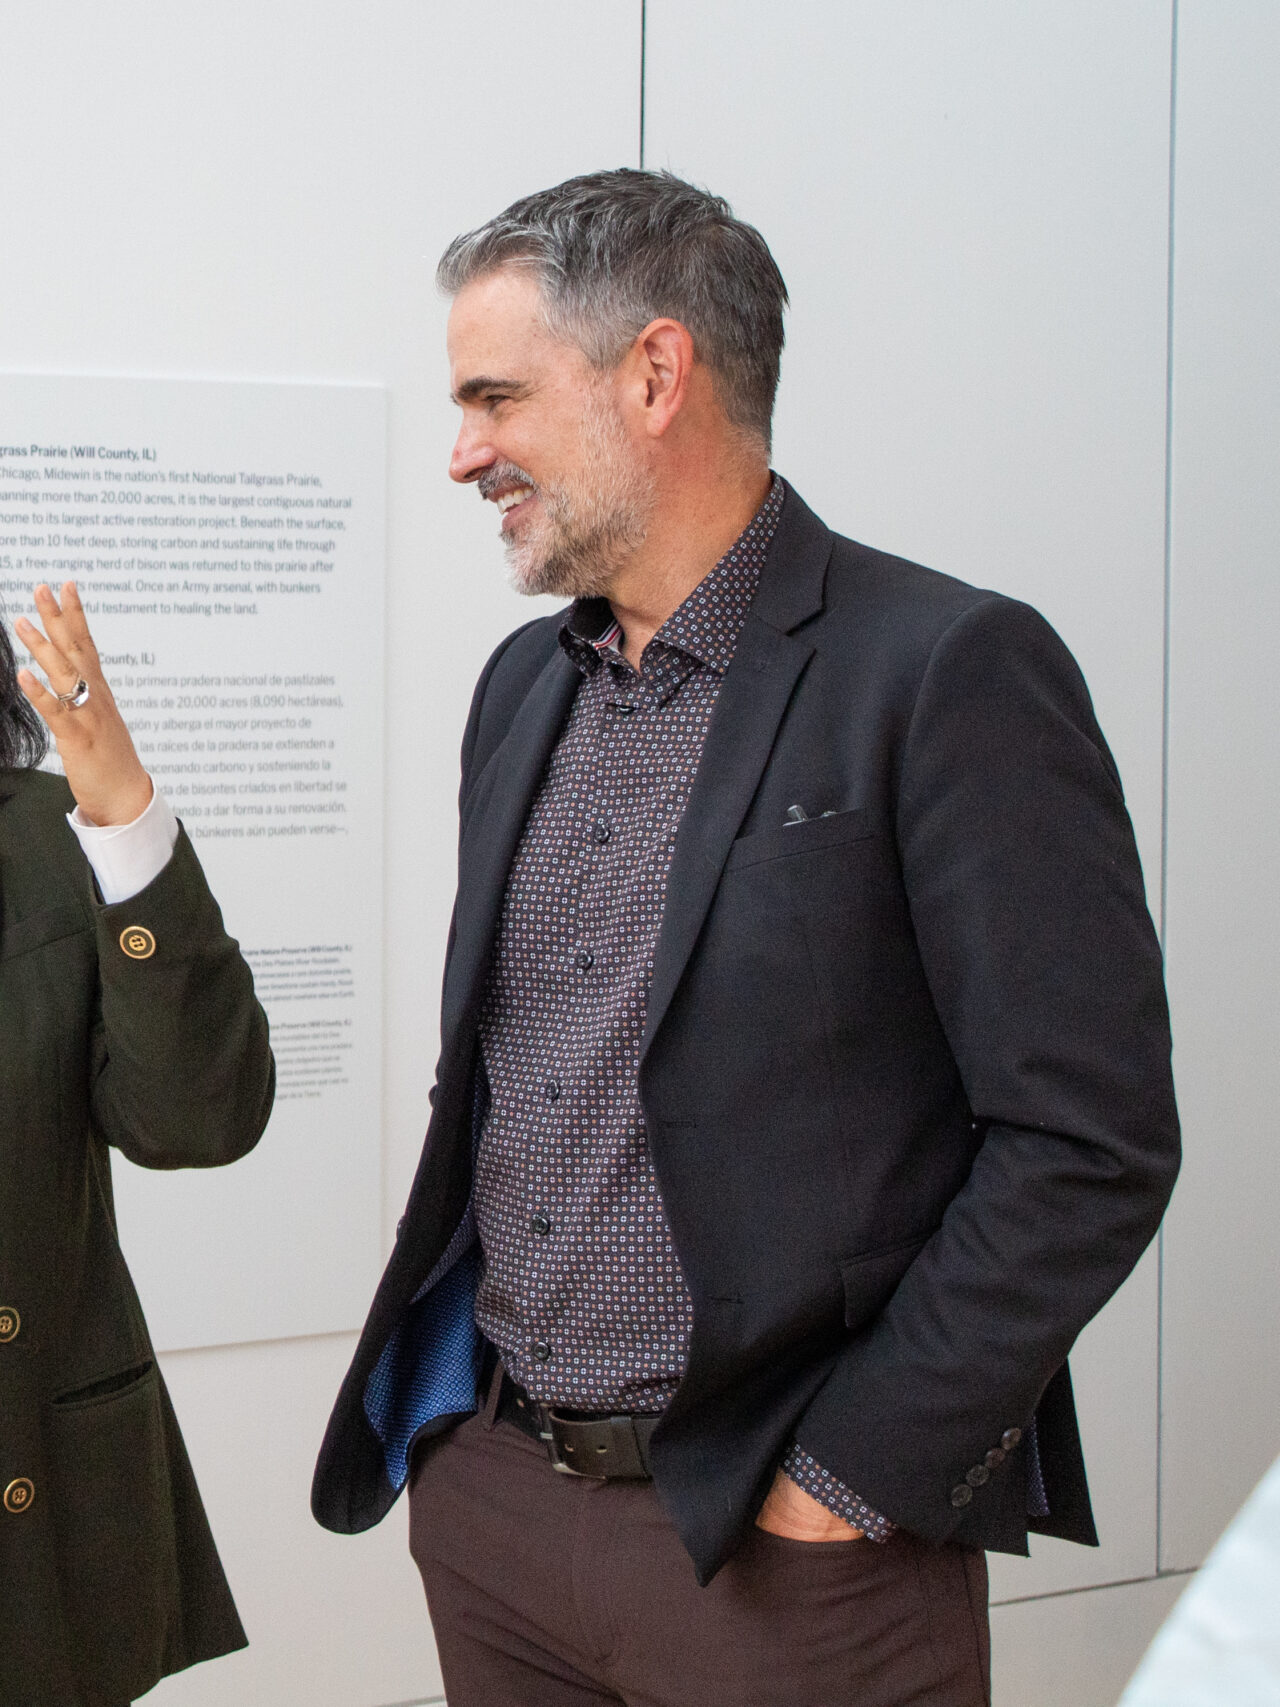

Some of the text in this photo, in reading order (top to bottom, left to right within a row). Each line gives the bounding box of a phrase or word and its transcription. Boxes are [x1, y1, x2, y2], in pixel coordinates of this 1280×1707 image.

[30, 445, 67, 457] Prairie
[70, 446, 95, 460] (Will
[142, 448, 156, 461] IL)
[44, 468, 89, 480] Midewin
[92, 470, 101, 480] is
[104, 470, 121, 481] the
[168, 471, 189, 482] first
[192, 472, 236, 483] National
[240, 473, 284, 487] Tallgrass
[42, 493, 70, 502] more
[73, 491, 98, 502] than
[178, 493, 185, 504] it
[187, 493, 196, 504] is
[199, 494, 216, 504] the
[218, 494, 254, 508] largest
[257, 495, 314, 509] contiguous
[316, 496, 351, 507] natural
[32, 512, 43, 523] to
[45, 512, 59, 523] its
[61, 513, 99, 526] largest
[102, 514, 134, 525] active
[137, 514, 196, 526] restoration
[240, 516, 284, 528] Beneath
[286, 517, 303, 528] the
[19, 534, 44, 545] than
[47, 535, 60, 546] 10
[63, 535, 85, 546] feet
[120, 536, 158, 550] storing
[160, 536, 197, 548] carbon
[200, 537, 219, 548] and
[222, 537, 275, 551] sustaining
[277, 538, 292, 549] life
[295, 538, 335, 552] through
[25, 557, 93, 571] free-ranging
[96, 558, 121, 568] herd
[123, 558, 134, 568] of
[137, 558, 166, 569] bison
[169, 561, 189, 569] was
[192, 558, 238, 569] returned
[240, 559, 251, 569] to
[253, 559, 272, 570] this
[274, 559, 307, 572] prairie
[309, 559, 333, 570] after
[135, 581, 163, 591] Once
[166, 583, 179, 591] an
[182, 581, 209, 594] Army
[255, 581, 277, 592] with
[279, 582, 320, 592] bunkers
[102, 602, 157, 613] testament
[160, 602, 170, 613] to
[173, 602, 211, 616] healing
[214, 603, 231, 613] the
[141, 653, 155, 666] IL)
[109, 674, 334, 688] es la primera pradera nacional de pastizales
[162, 718, 201, 731] alberga
[204, 718, 213, 728] el
[215, 720, 247, 731] mayor
[250, 717, 296, 730] proyecto
[298, 717, 311, 728] de
[140, 741, 154, 751] las
[191, 740, 204, 750] de
[207, 740, 216, 750] la
[218, 739, 259, 753] pradera
[261, 741, 273, 749] se
[275, 738, 326, 749] extienden
[175, 783, 188, 794] de
[191, 782, 236, 794] bisontes
[239, 782, 276, 793] criados
[279, 784, 291, 792] en
[293, 781, 333, 792] libertad
[335, 783, 346, 792] se
